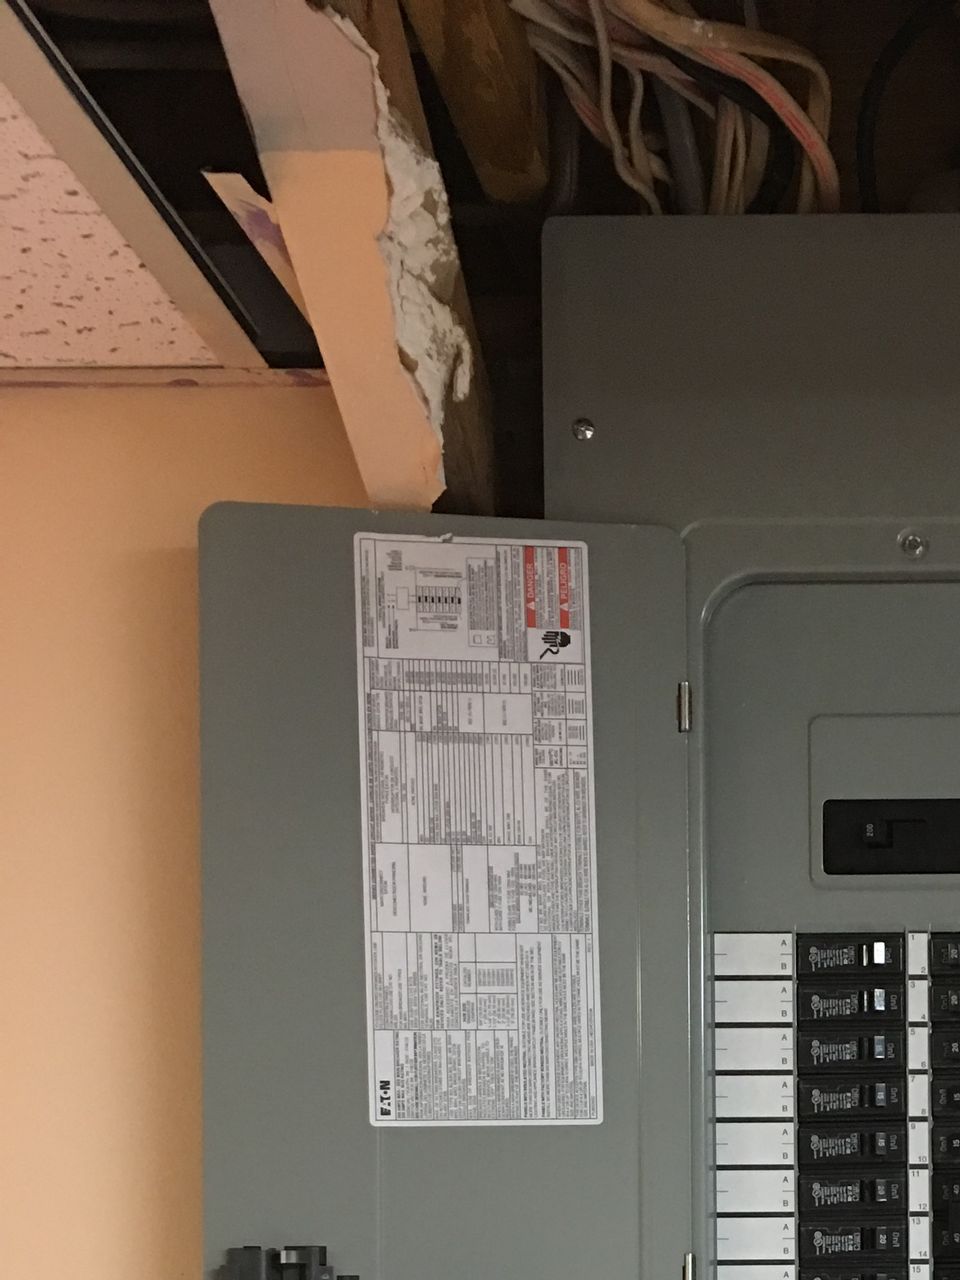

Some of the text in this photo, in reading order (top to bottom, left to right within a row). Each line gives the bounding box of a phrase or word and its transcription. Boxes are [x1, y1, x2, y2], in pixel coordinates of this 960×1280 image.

[526, 563, 534, 598] DANGER
[560, 562, 568, 600] PELIGRO
[866, 824, 874, 837] 200
[951, 949, 958, 959] 20
[780, 962, 787, 971] B
[780, 986, 787, 994] A
[951, 995, 958, 1005] 20
[781, 1009, 788, 1018] B
[952, 1043, 959, 1052] 20
[781, 1057, 788, 1065] B
[380, 1080, 391, 1116] EATON
[877, 1091, 884, 1099] 15
[782, 1152, 789, 1160] B
[878, 1185, 885, 1195] 20
[953, 1185, 960, 1195] 40
[879, 1234, 887, 1244] 20
[953, 1233, 960, 1243] 40
[912, 1266, 921, 1274] 15
